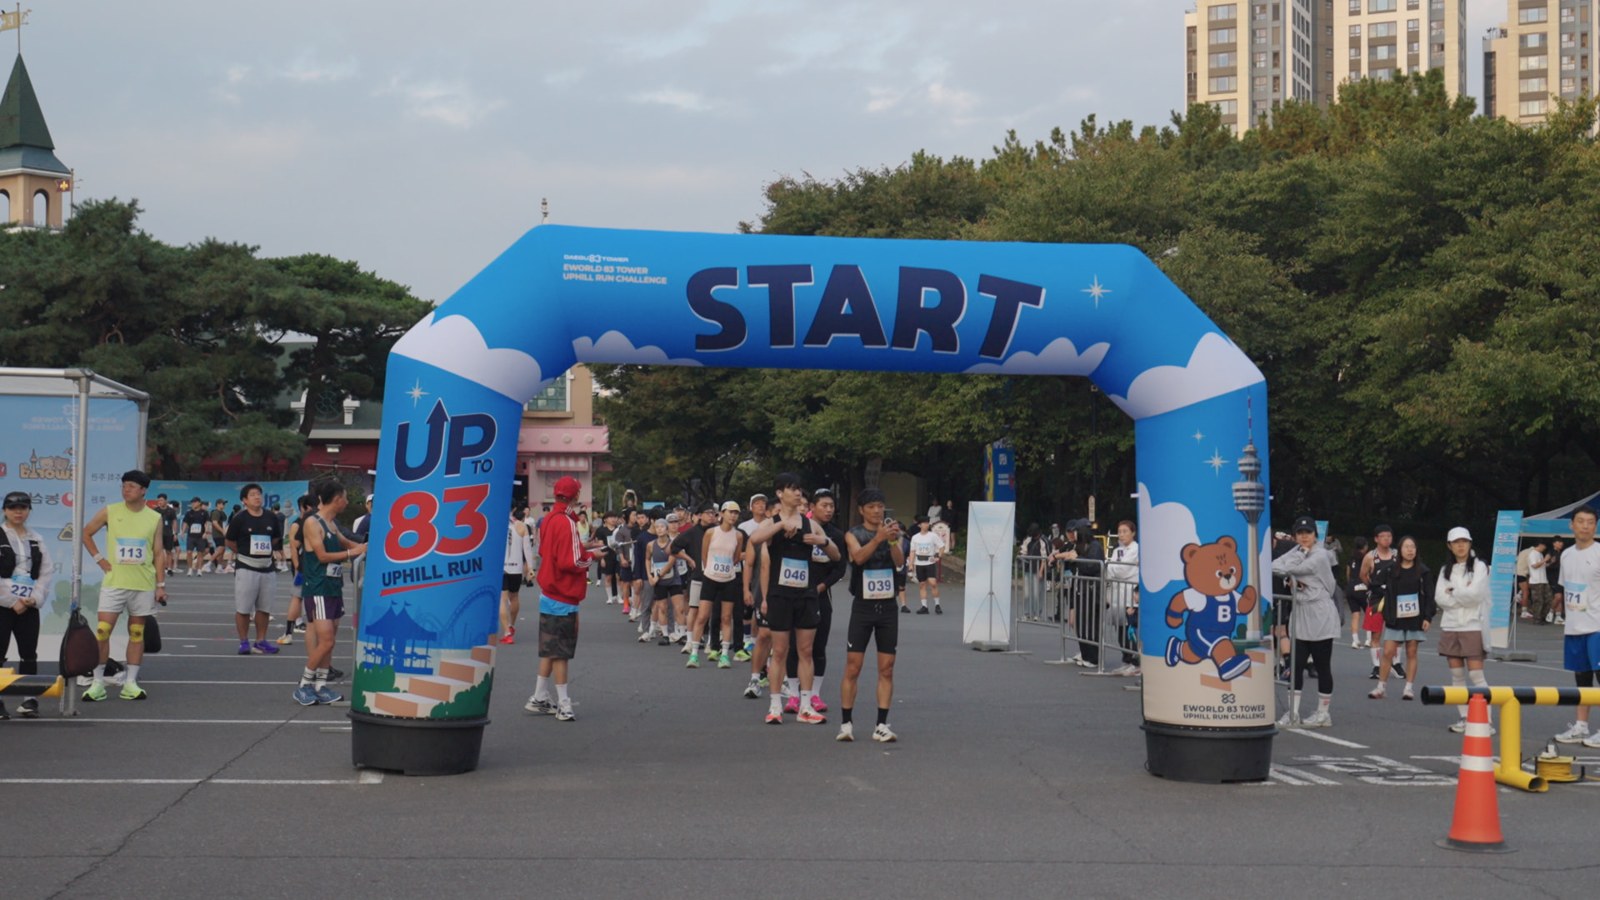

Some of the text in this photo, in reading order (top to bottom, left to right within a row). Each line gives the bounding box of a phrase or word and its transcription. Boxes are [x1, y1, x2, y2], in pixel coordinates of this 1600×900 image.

[563, 264, 649, 274] EWORLD 83 TOWER
[563, 272, 667, 285] UPHILL RUN CHALLENGE
[686, 264, 1046, 360] START
[394, 397, 498, 483] UP
[471, 459, 494, 475] TO
[384, 483, 491, 564] 83
[254, 542, 270, 550] 184
[120, 548, 142, 558] 113
[382, 557, 483, 587] UPHILL RUN
[784, 568, 806, 581] 046
[11, 584, 33, 597] 227
[868, 579, 891, 592] 039
[1218, 605, 1231, 622] B
[1399, 602, 1417, 612] 151
[1221, 693, 1236, 704] 83
[1183, 705, 1224, 713] EWORLD
[1226, 705, 1238, 713] 83
